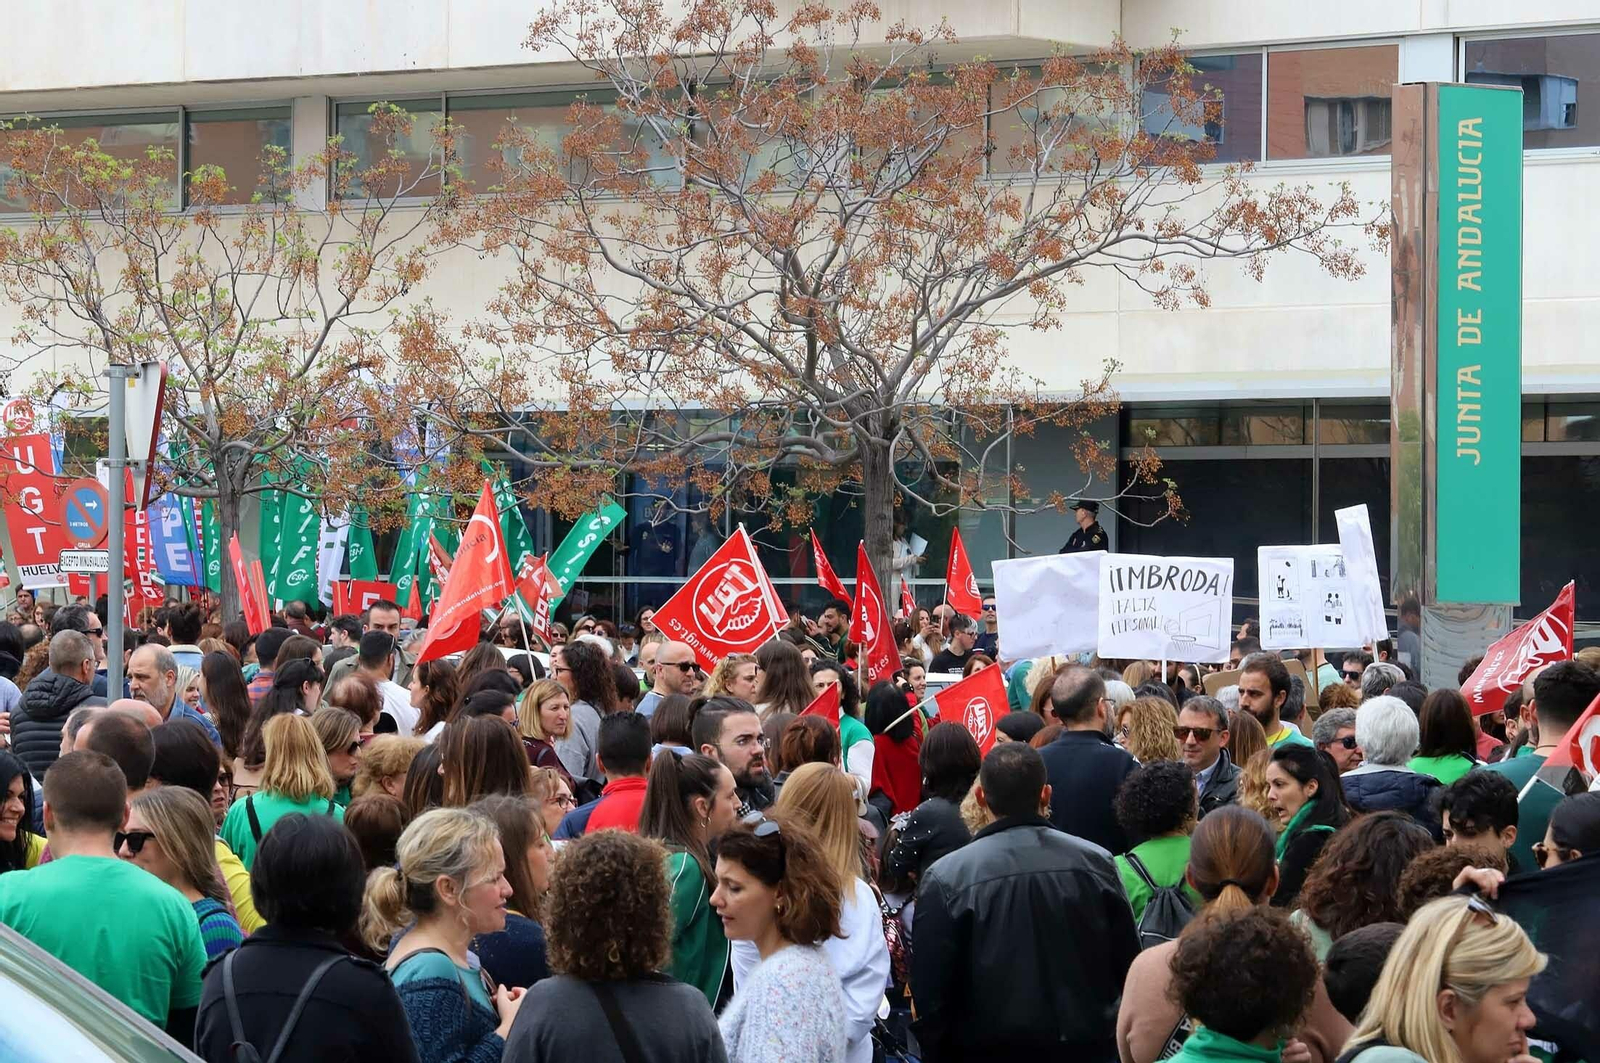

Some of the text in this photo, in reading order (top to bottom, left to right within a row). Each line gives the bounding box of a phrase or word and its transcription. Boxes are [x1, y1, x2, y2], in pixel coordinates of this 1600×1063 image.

[1457, 308, 1482, 346] DE
[1456, 365, 1481, 466] JUNTA
[22, 563, 60, 578] HUELV
[1109, 565, 1230, 597] ¡IMBRODA!
[699, 563, 758, 626] UGT
